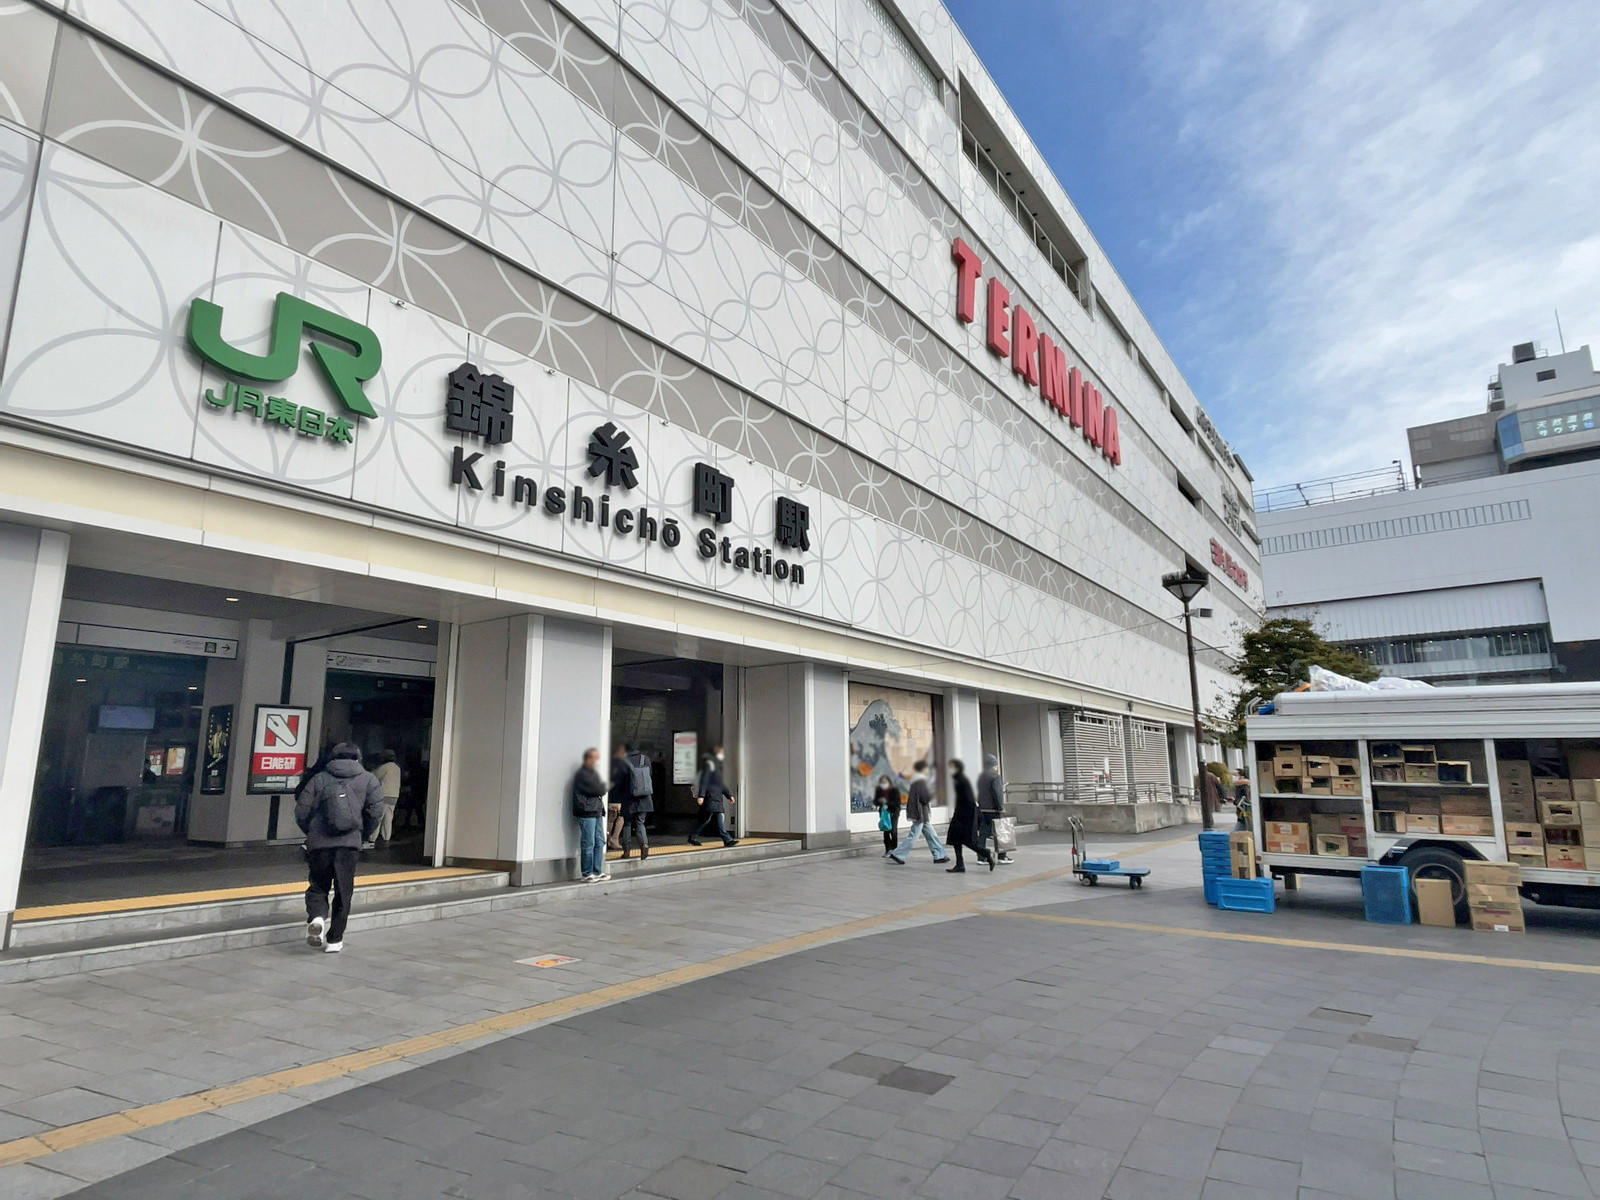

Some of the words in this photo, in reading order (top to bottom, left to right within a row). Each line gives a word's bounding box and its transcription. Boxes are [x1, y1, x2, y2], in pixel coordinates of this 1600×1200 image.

[190, 291, 383, 419] JR
[204, 379, 355, 445] JR東日本
[952, 236, 1122, 466] TERMINA
[445, 361, 811, 553] 錦糸町駅
[451, 445, 683, 549] Kinshichō
[698, 527, 806, 586] Station
[260, 756, 297, 771] 日能研
